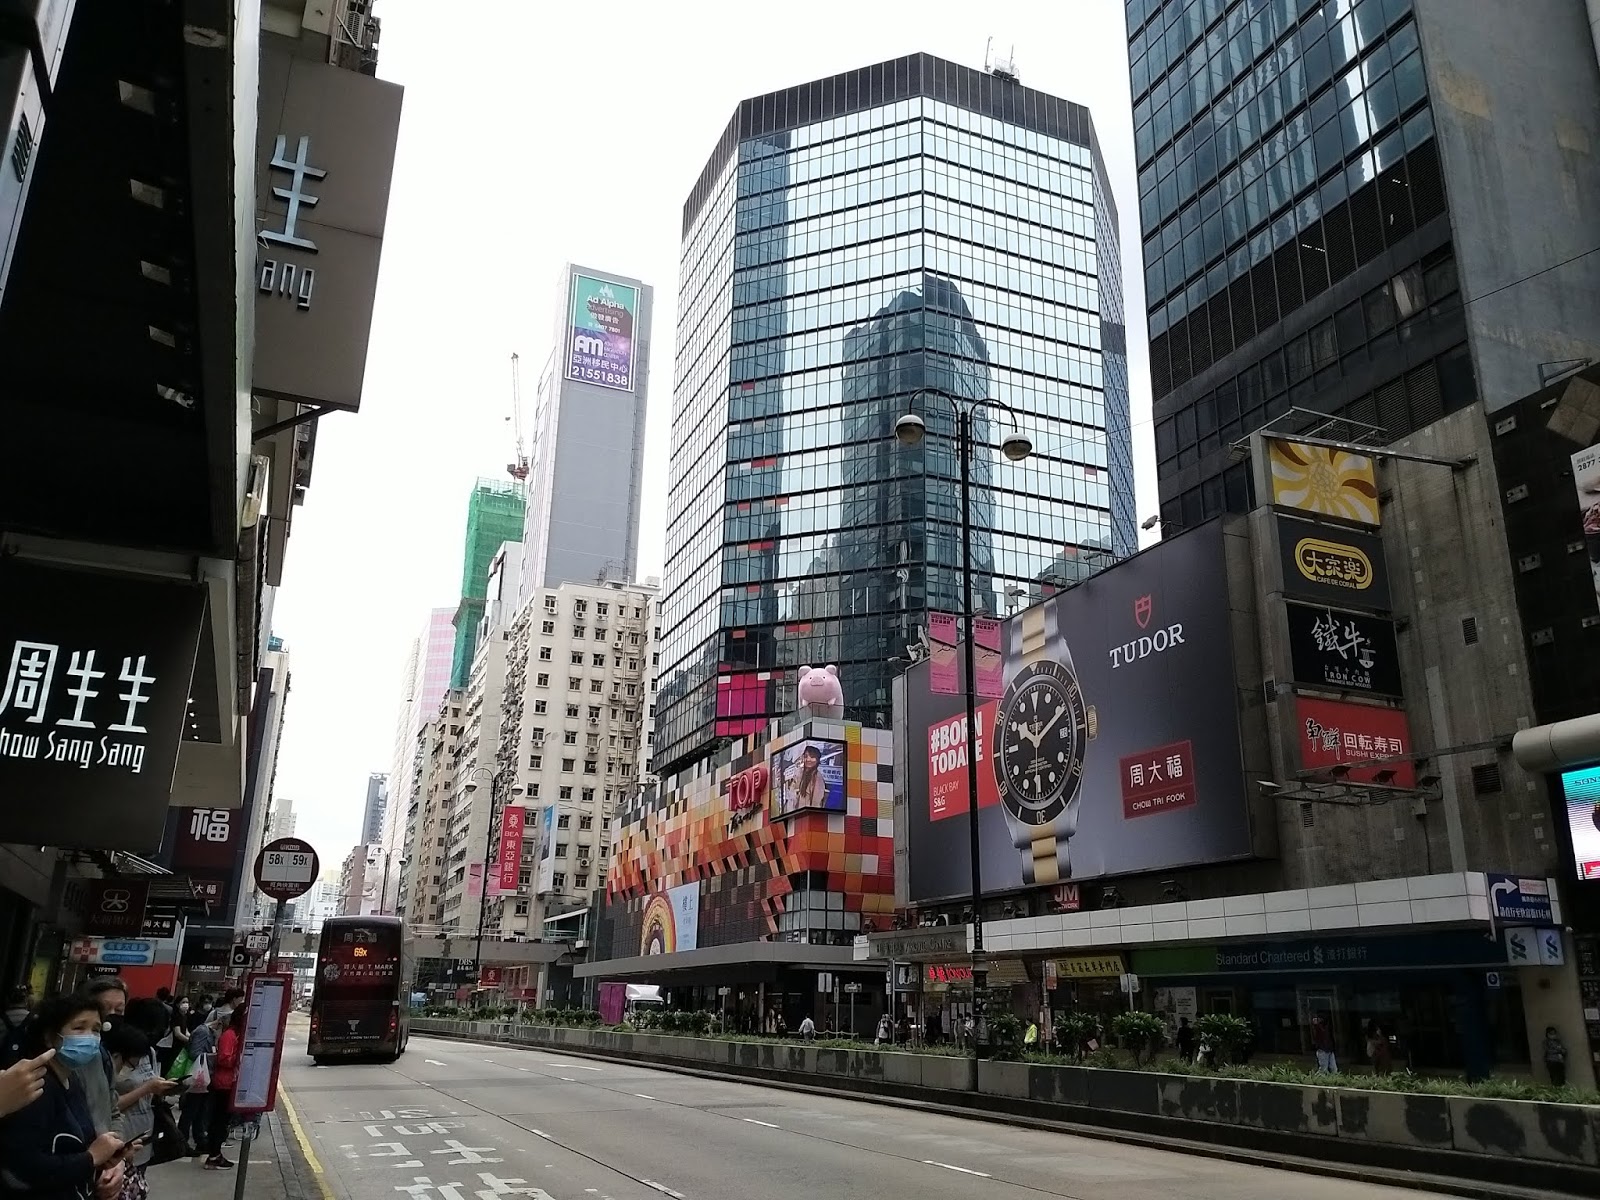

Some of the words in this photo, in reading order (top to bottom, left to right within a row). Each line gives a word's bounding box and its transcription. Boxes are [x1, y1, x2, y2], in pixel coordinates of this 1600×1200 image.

[258, 134, 327, 254] 生
[587, 295, 598, 304] Ad
[601, 298, 624, 310] Alpha
[573, 354, 628, 374] 亞洲移民中心
[572, 366, 628, 386] 21551838
[1577, 459, 1596, 472] 2877
[1338, 580, 1357, 589] CORAL
[1109, 622, 1185, 669] TUDOR
[0, 640, 156, 733] 周生生
[1324, 671, 1348, 680] IRON
[1351, 674, 1371, 684] COW
[44, 730, 94, 769] Sang
[97, 736, 146, 774] Sang
[1344, 732, 1402, 754] 回転寿司
[931, 739, 983, 776] TODAE
[1346, 750, 1368, 758] SUSHI
[1130, 754, 1183, 788] 周大福
[934, 783, 948, 797] BLACK
[949, 780, 960, 793] BAY
[934, 796, 946, 808] S&G
[1132, 800, 1152, 811] CHOW
[1152, 796, 1164, 808] TAI
[1166, 792, 1186, 804] FOOK
[189, 807, 230, 842] 福
[503, 840, 516, 883] 東亞銀行
[1055, 884, 1078, 902] JM
[144, 919, 170, 929] 周大福
[1216, 952, 1258, 966] Standard
[1260, 950, 1310, 964] Chartered
[1327, 946, 1368, 960] 渣打銀行
